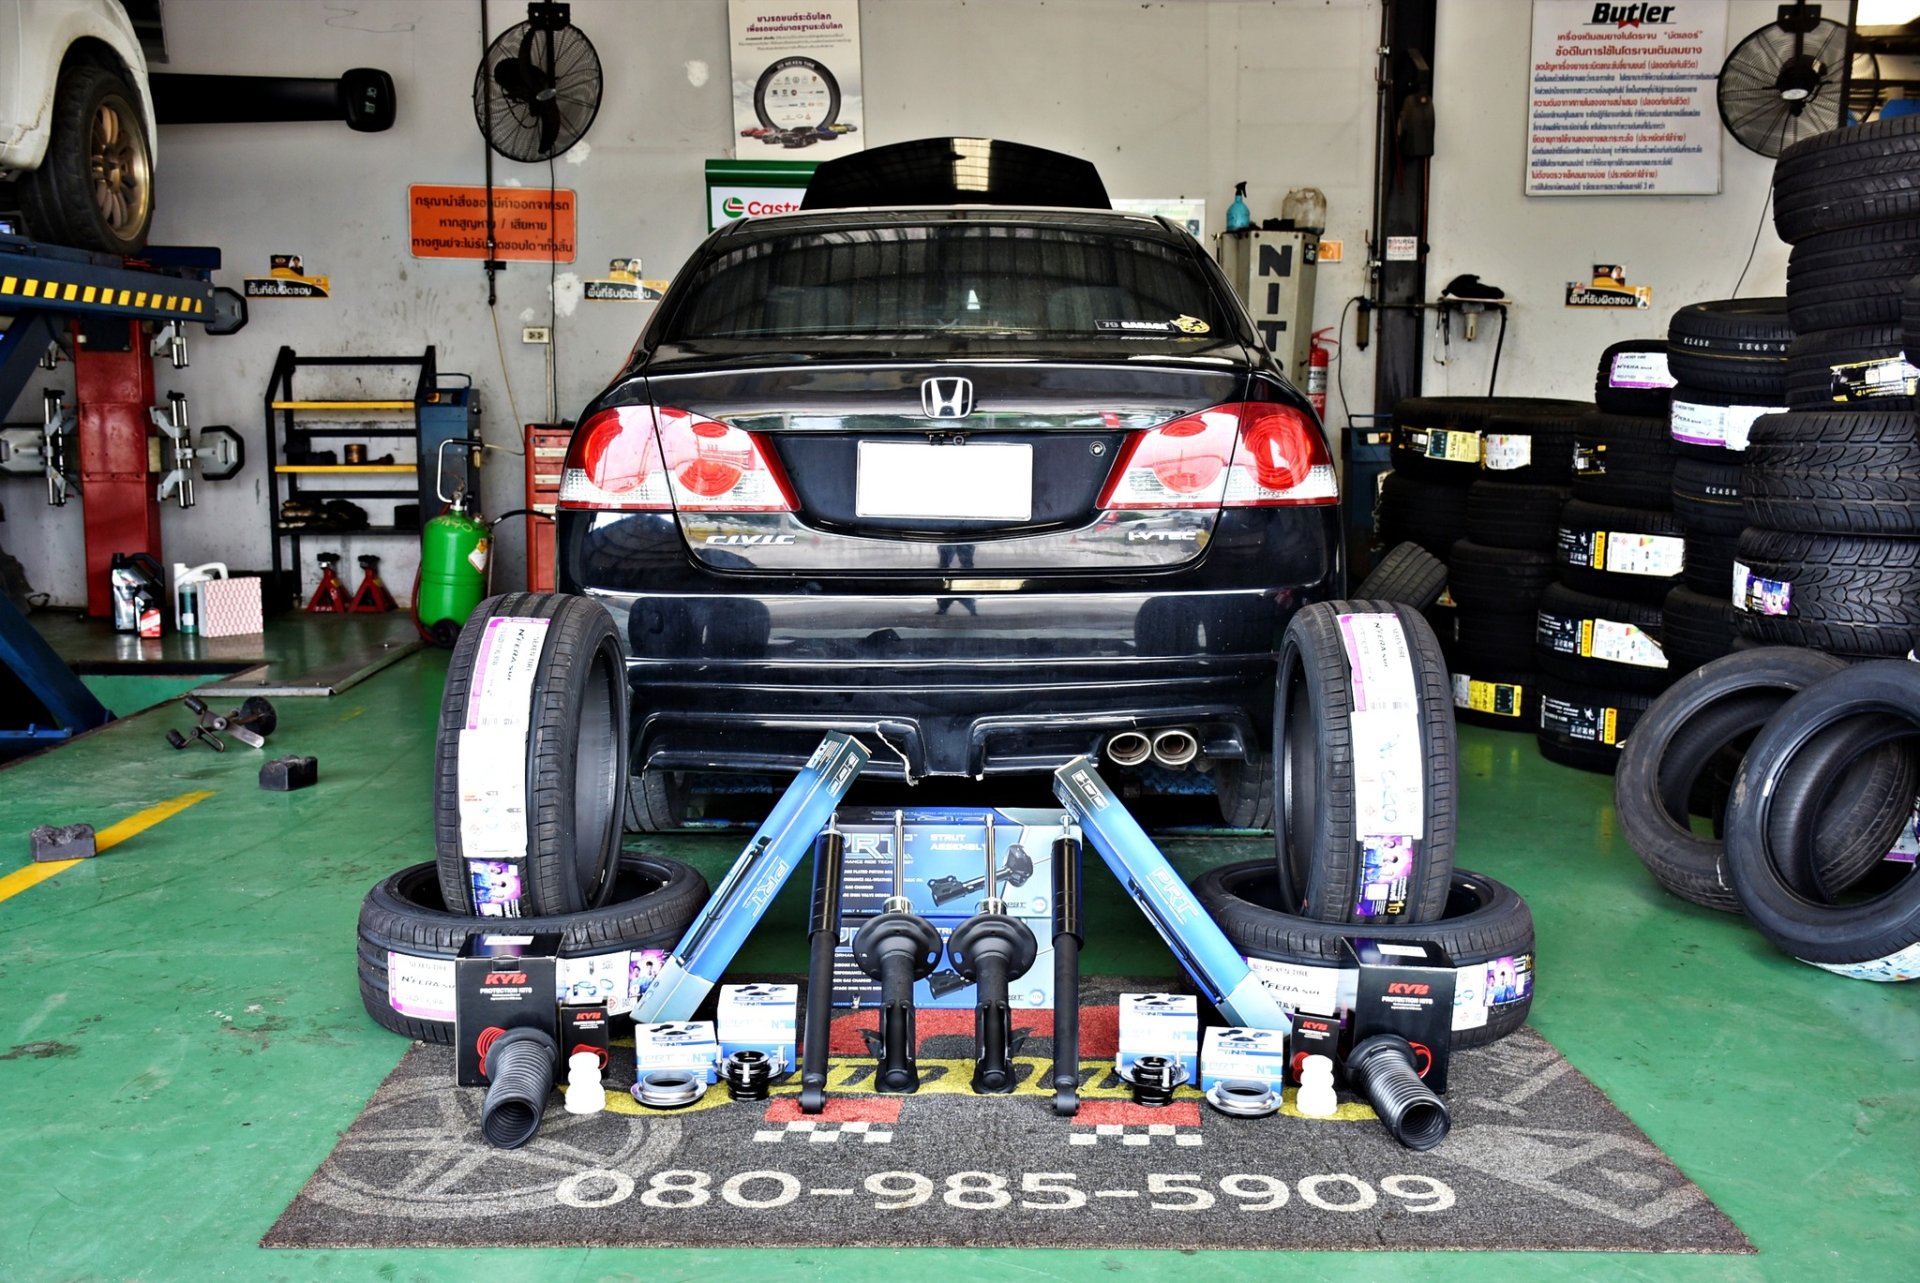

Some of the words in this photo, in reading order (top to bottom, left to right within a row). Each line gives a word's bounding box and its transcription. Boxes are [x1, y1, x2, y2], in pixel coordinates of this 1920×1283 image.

[1592, 3, 1675, 24] Butler
[415, 194, 570, 211] กรุณานำสิ่งขอมีค่าออกจากรถ
[747, 201, 800, 216] Castr
[510, 221, 548, 230] เสียหาย
[705, 534, 796, 546] CIVIC
[929, 833, 967, 842] STRUT
[1151, 865, 1201, 918] PRT
[484, 973, 528, 985] KYB
[1387, 982, 1430, 995] KYB
[1381, 995, 1419, 1004] PROTECTION
[576, 1012, 602, 1020] KYB
[1302, 1021, 1329, 1031] KYB
[554, 1170, 1457, 1213] 080-985-5909
